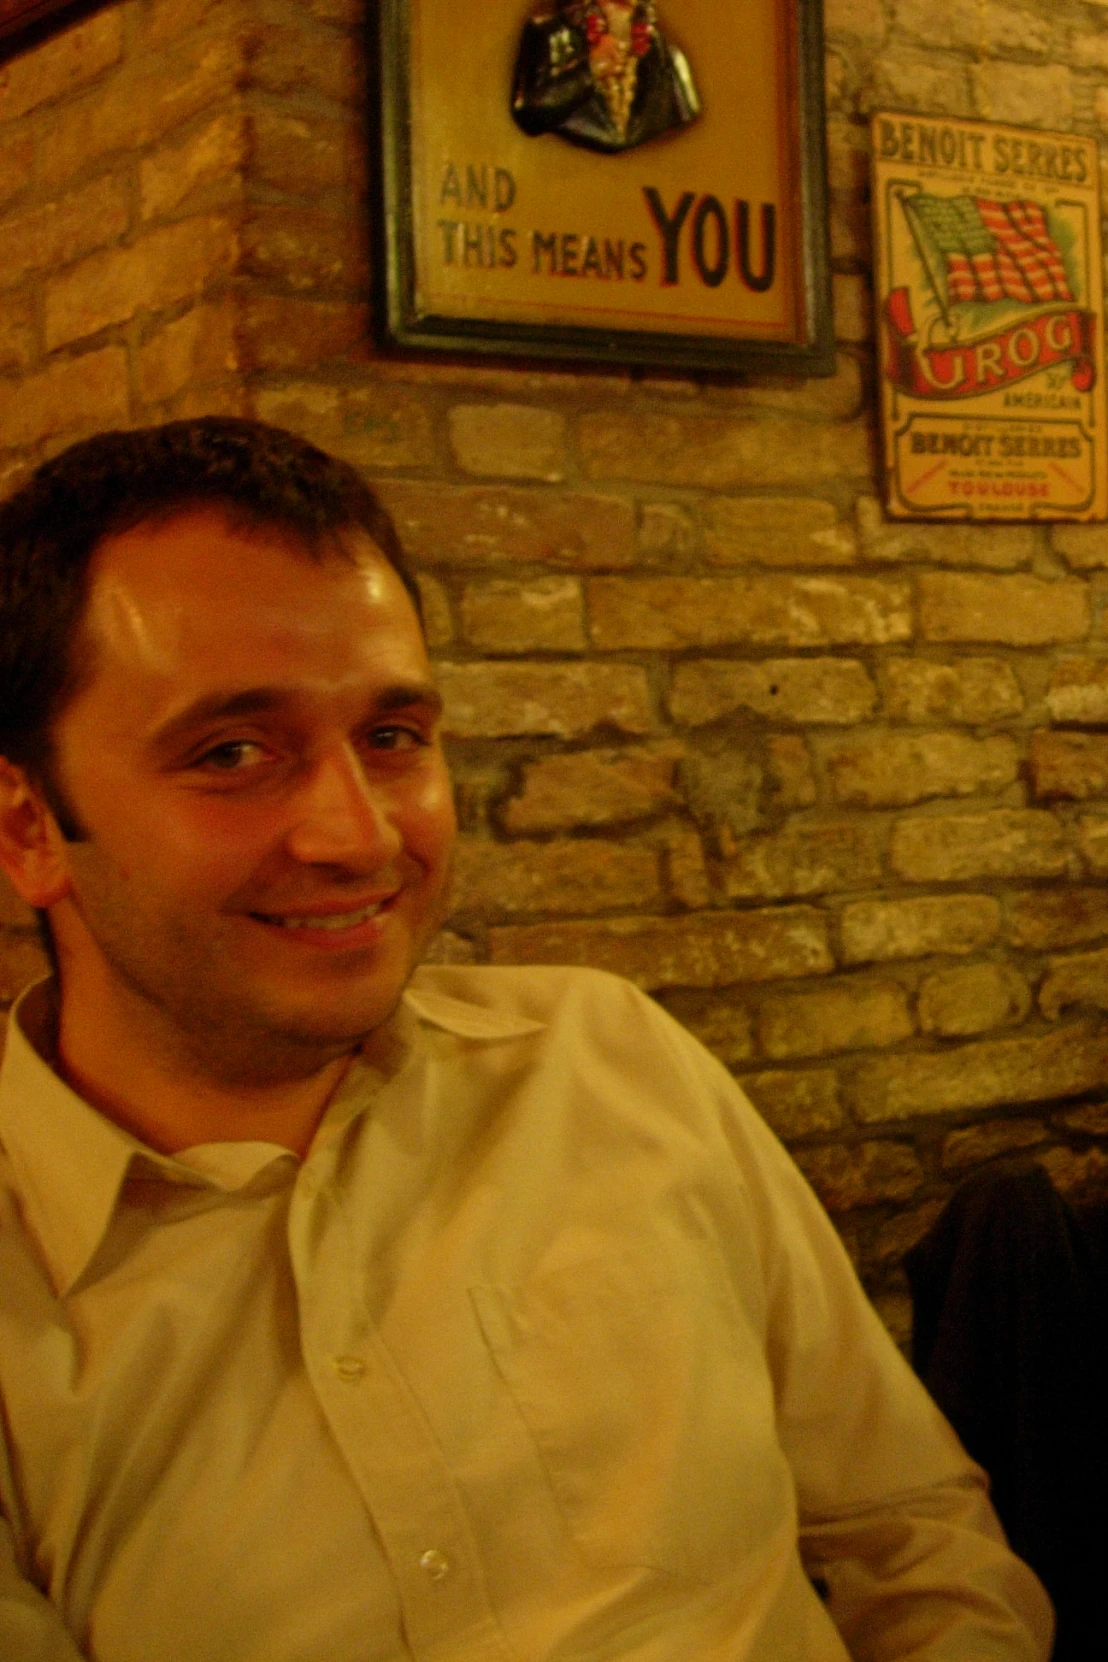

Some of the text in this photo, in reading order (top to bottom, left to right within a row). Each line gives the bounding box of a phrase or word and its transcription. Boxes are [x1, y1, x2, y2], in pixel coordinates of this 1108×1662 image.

[881, 118, 1088, 183] BENOIT SERRES
[440, 162, 517, 214] AND
[437, 186, 776, 293] THIS MEANS YOU
[911, 432, 993, 456] BENOIT
